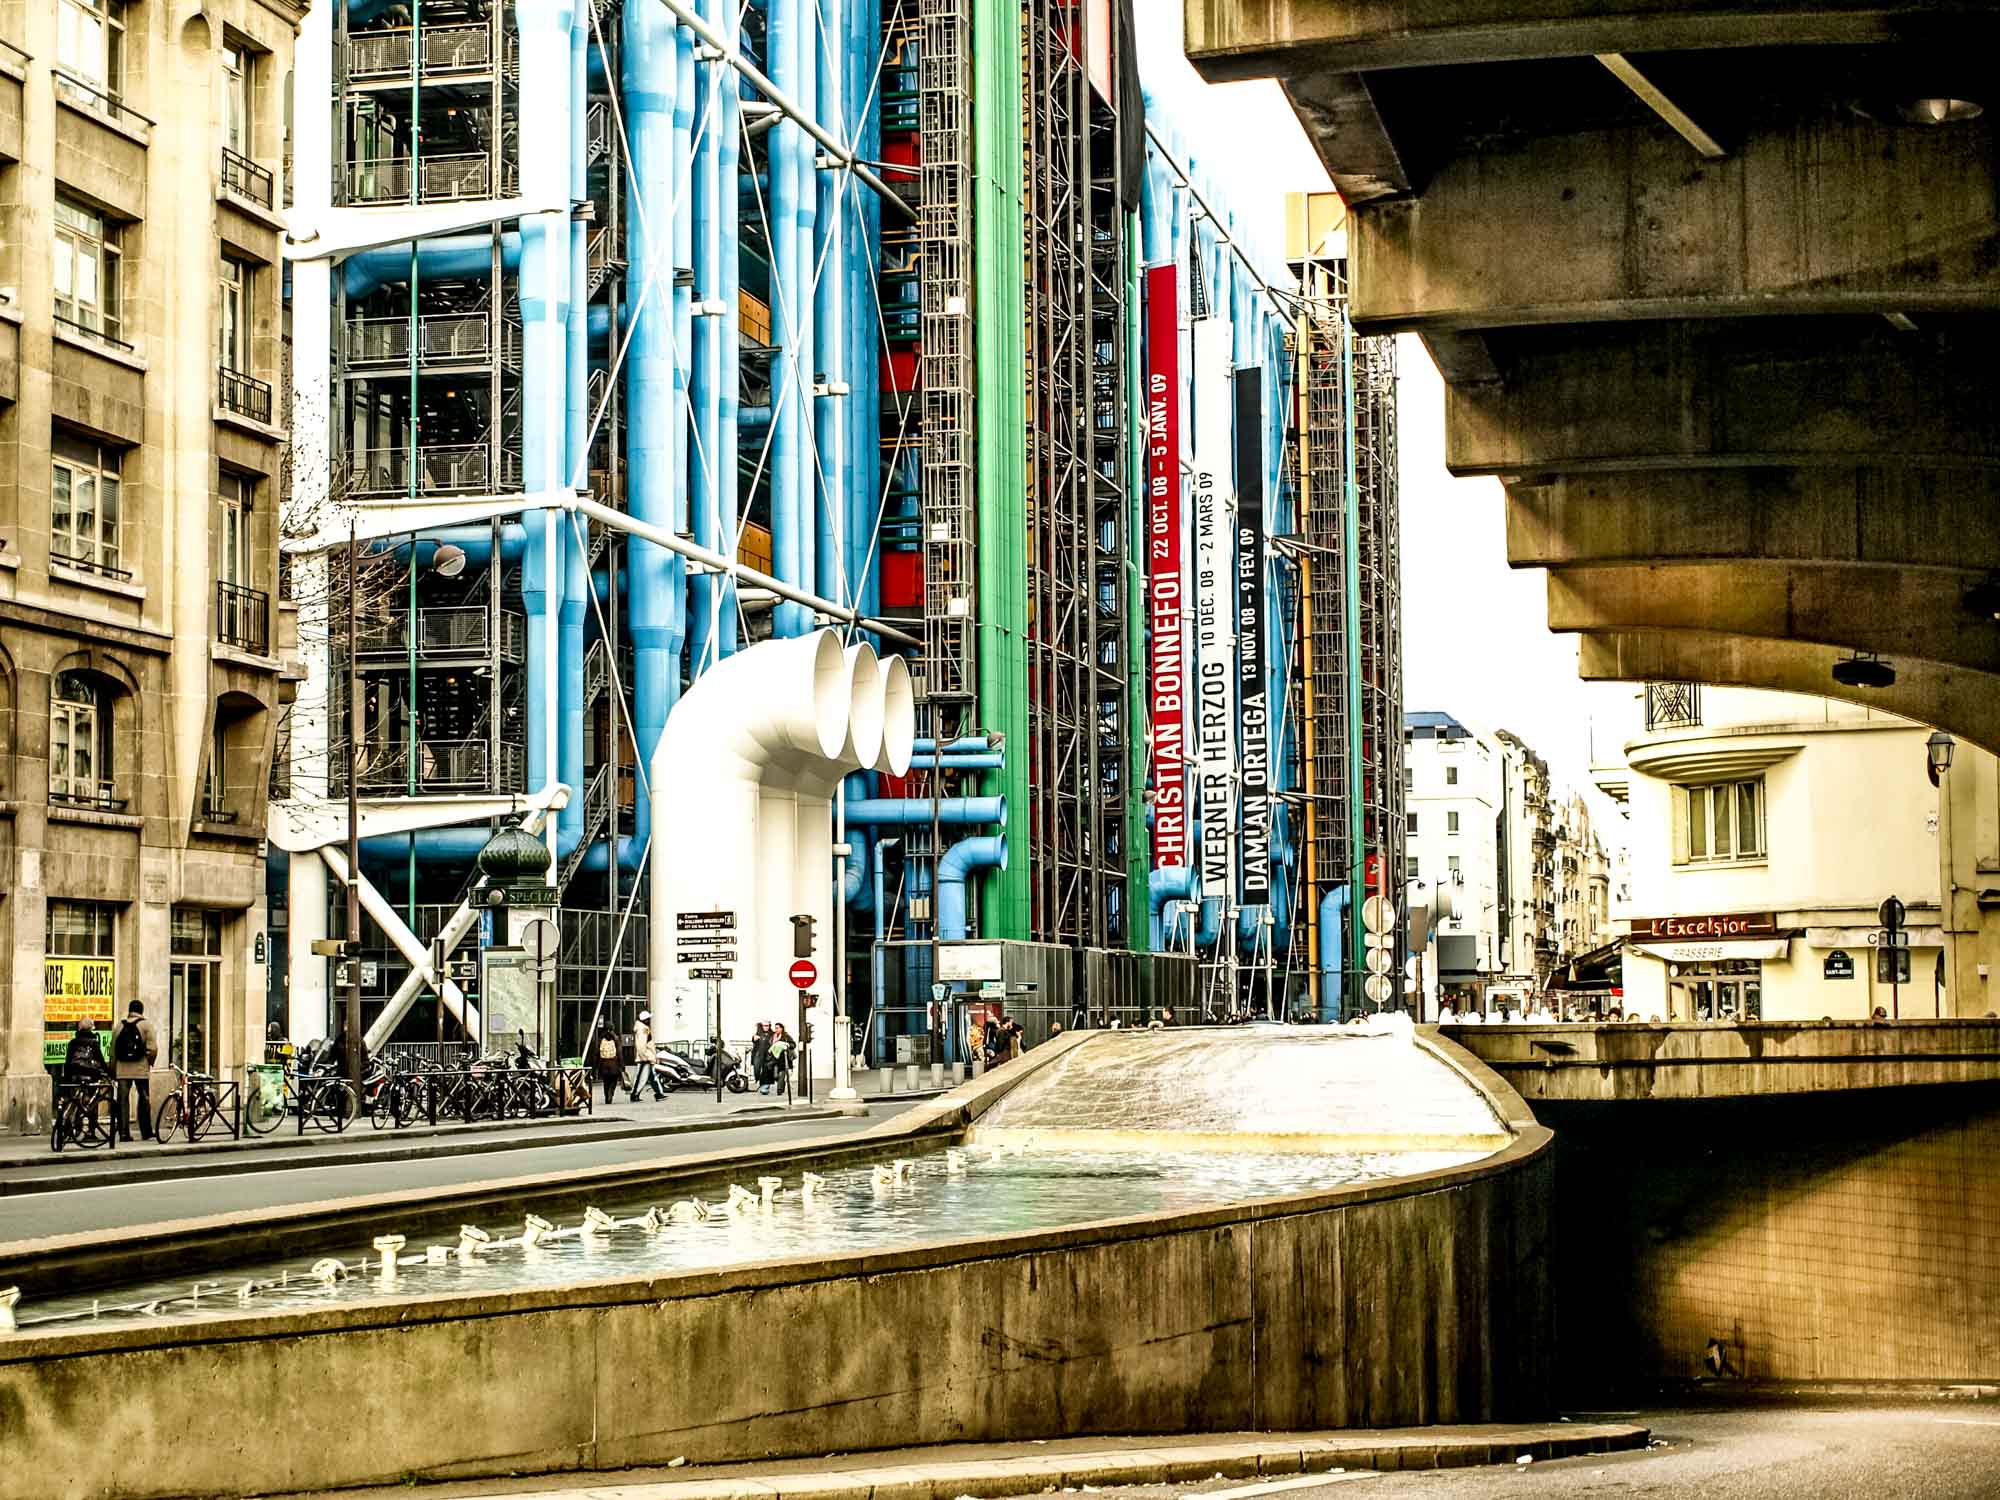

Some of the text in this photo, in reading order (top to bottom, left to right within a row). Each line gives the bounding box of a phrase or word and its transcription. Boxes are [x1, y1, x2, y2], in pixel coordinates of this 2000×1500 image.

[1150, 373, 1167, 393] 09
[1151, 397, 1168, 442] JANV.
[1151, 445, 1168, 457] 5
[1152, 476, 1168, 496] 08
[1198, 472, 1213, 489] 09
[1152, 500, 1169, 534] OCT.
[1199, 494, 1213, 536] MARS
[1199, 541, 1213, 551] 2
[1239, 528, 1255, 546] 09
[1152, 538, 1169, 559] 22
[1200, 570, 1214, 588] 08
[1240, 582, 1255, 591] 9
[1241, 608, 1256, 626] 08
[1153, 571, 1182, 712] BONNEFOI
[1200, 631, 1215, 649] 10
[1241, 629, 1257, 660] NOV.
[1242, 664, 1257, 682] 13
[1202, 662, 1226, 761] HERZOG
[1242, 691, 1267, 786] ORTEGA
[1156, 723, 1184, 868] CHRISTIAN
[1204, 773, 1229, 883] WERNER
[1243, 795, 1269, 891] DAMIAN
[1651, 916, 1748, 936] L'Excelsior
